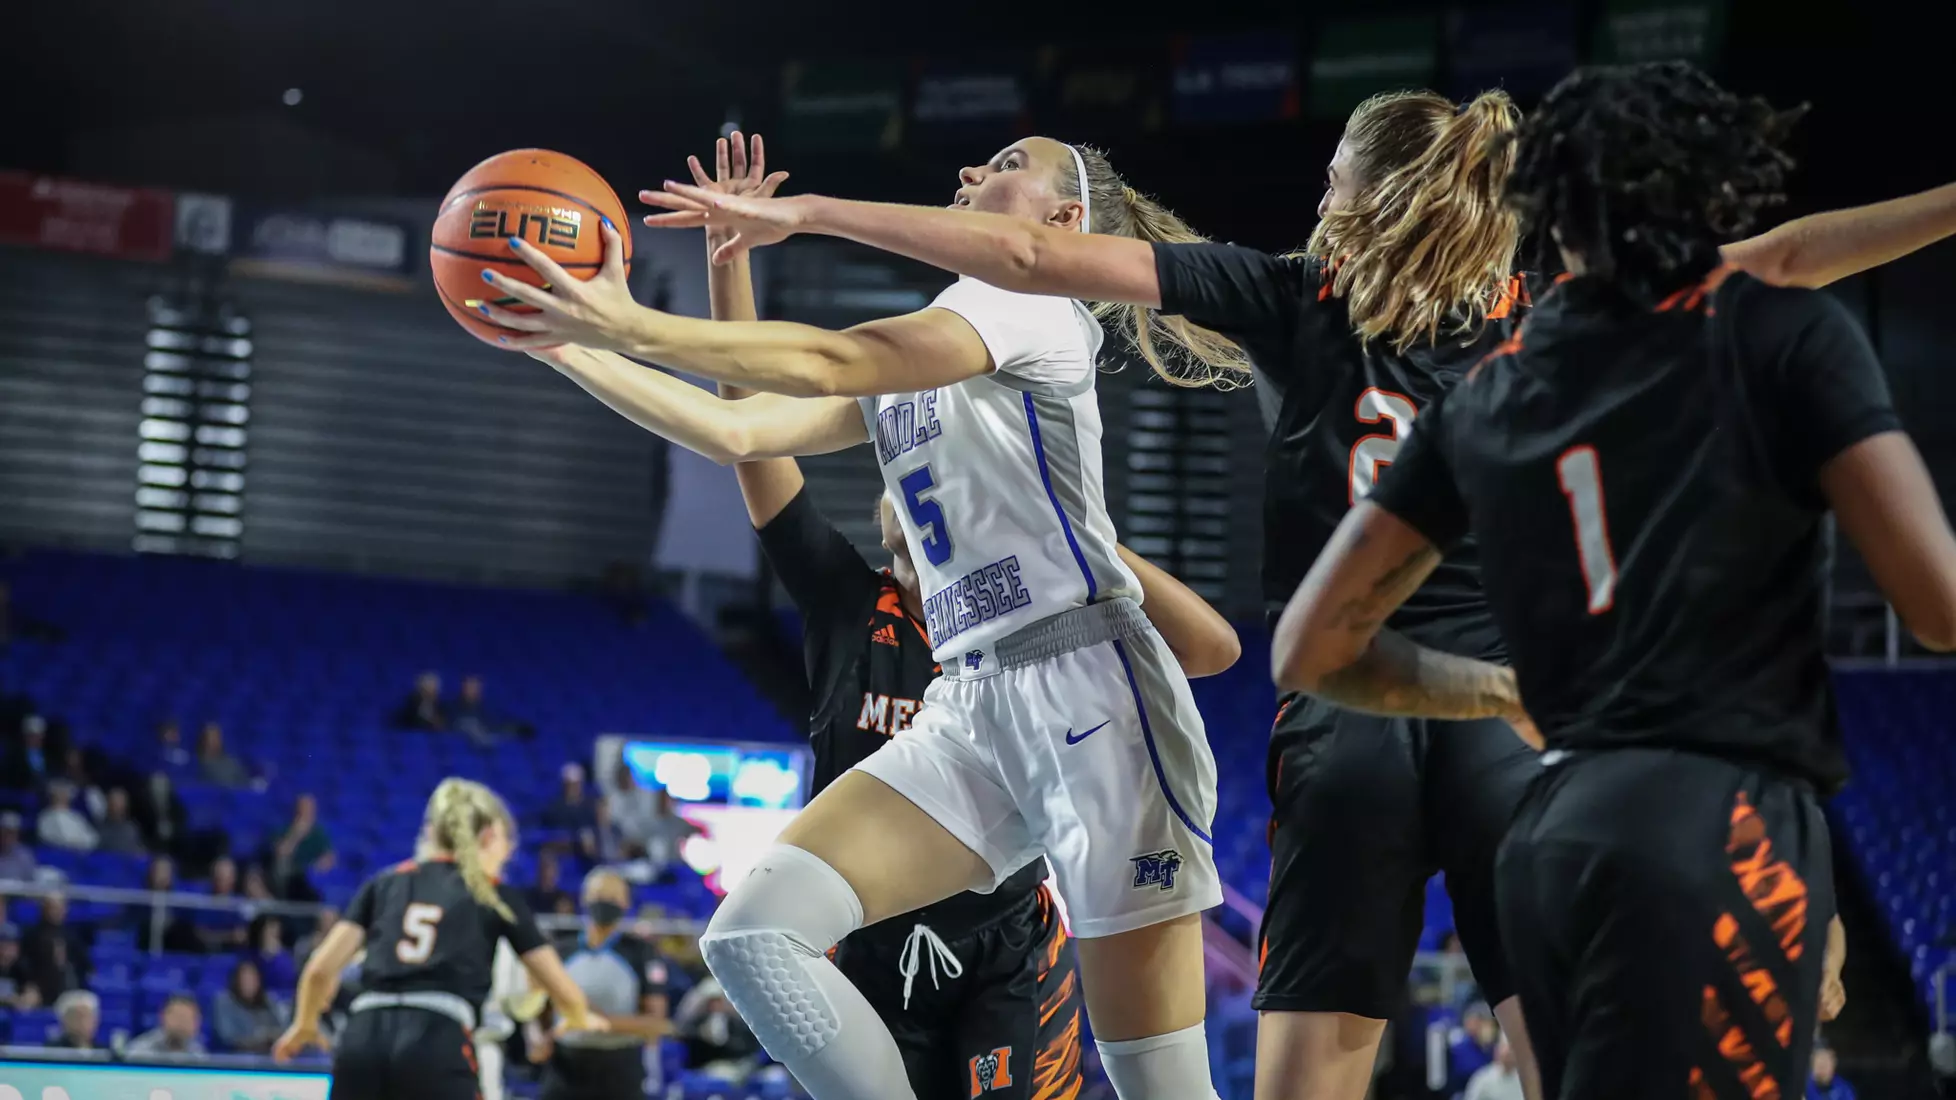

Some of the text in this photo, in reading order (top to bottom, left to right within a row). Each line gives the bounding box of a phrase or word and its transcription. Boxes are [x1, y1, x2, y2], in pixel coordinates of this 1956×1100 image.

[469, 210, 581, 250] ELITE
[898, 463, 954, 569] 5
[1555, 443, 1619, 615] 1
[856, 692, 923, 737] ME
[1132, 854, 1182, 890] MT
[395, 901, 445, 965] 5
